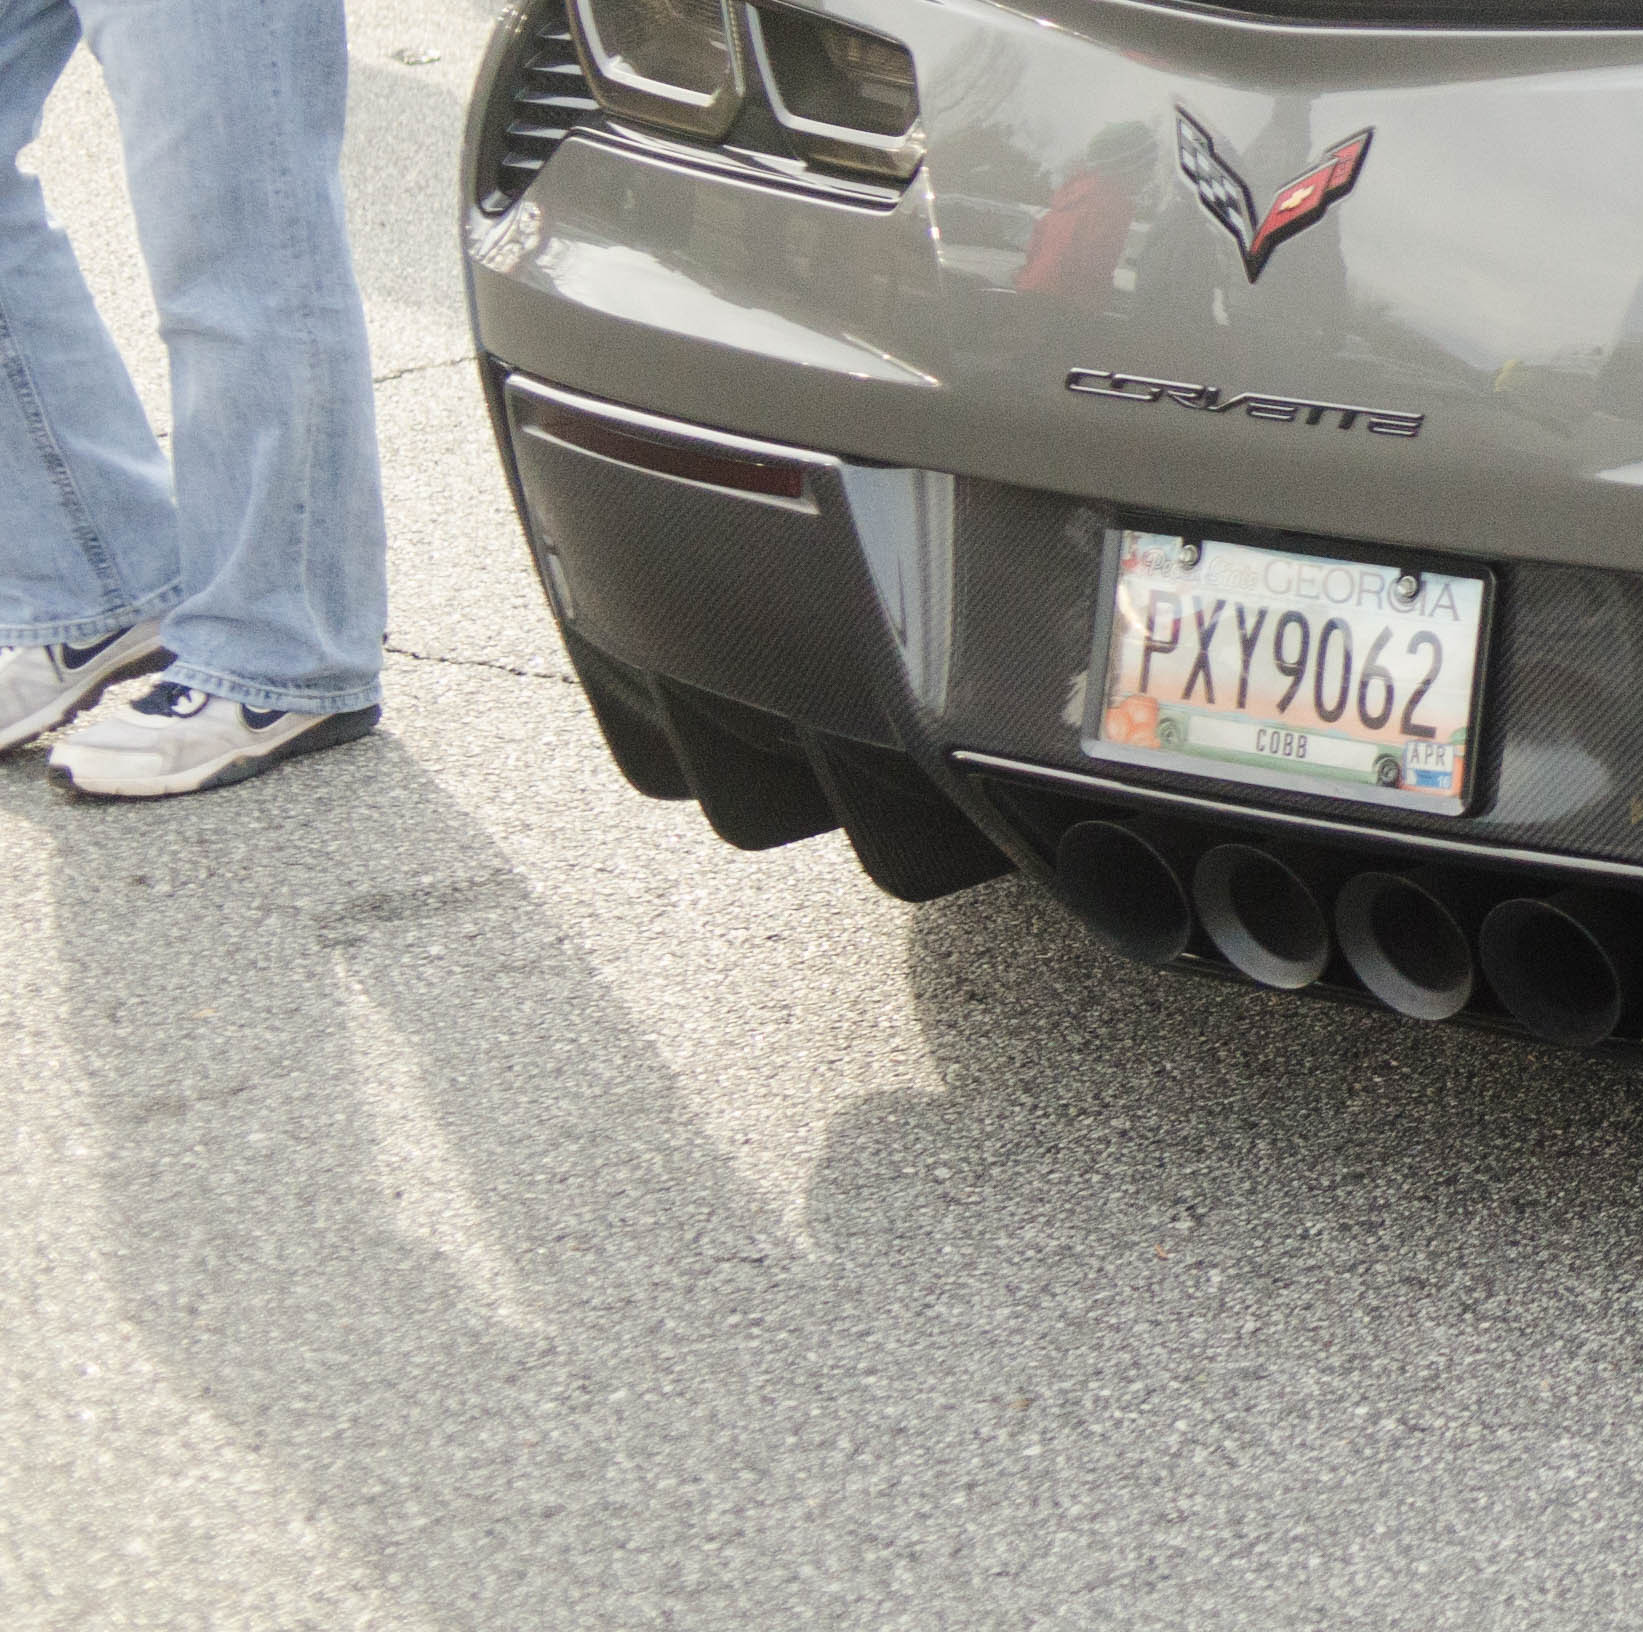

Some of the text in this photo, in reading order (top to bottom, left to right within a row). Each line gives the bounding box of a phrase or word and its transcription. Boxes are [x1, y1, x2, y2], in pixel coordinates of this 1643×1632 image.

[1065, 367, 1426, 438] CORVETTE
[1138, 589, 1443, 739] PXY9062
[1255, 728, 1309, 760] COBB
[1409, 742, 1446, 767] APR
